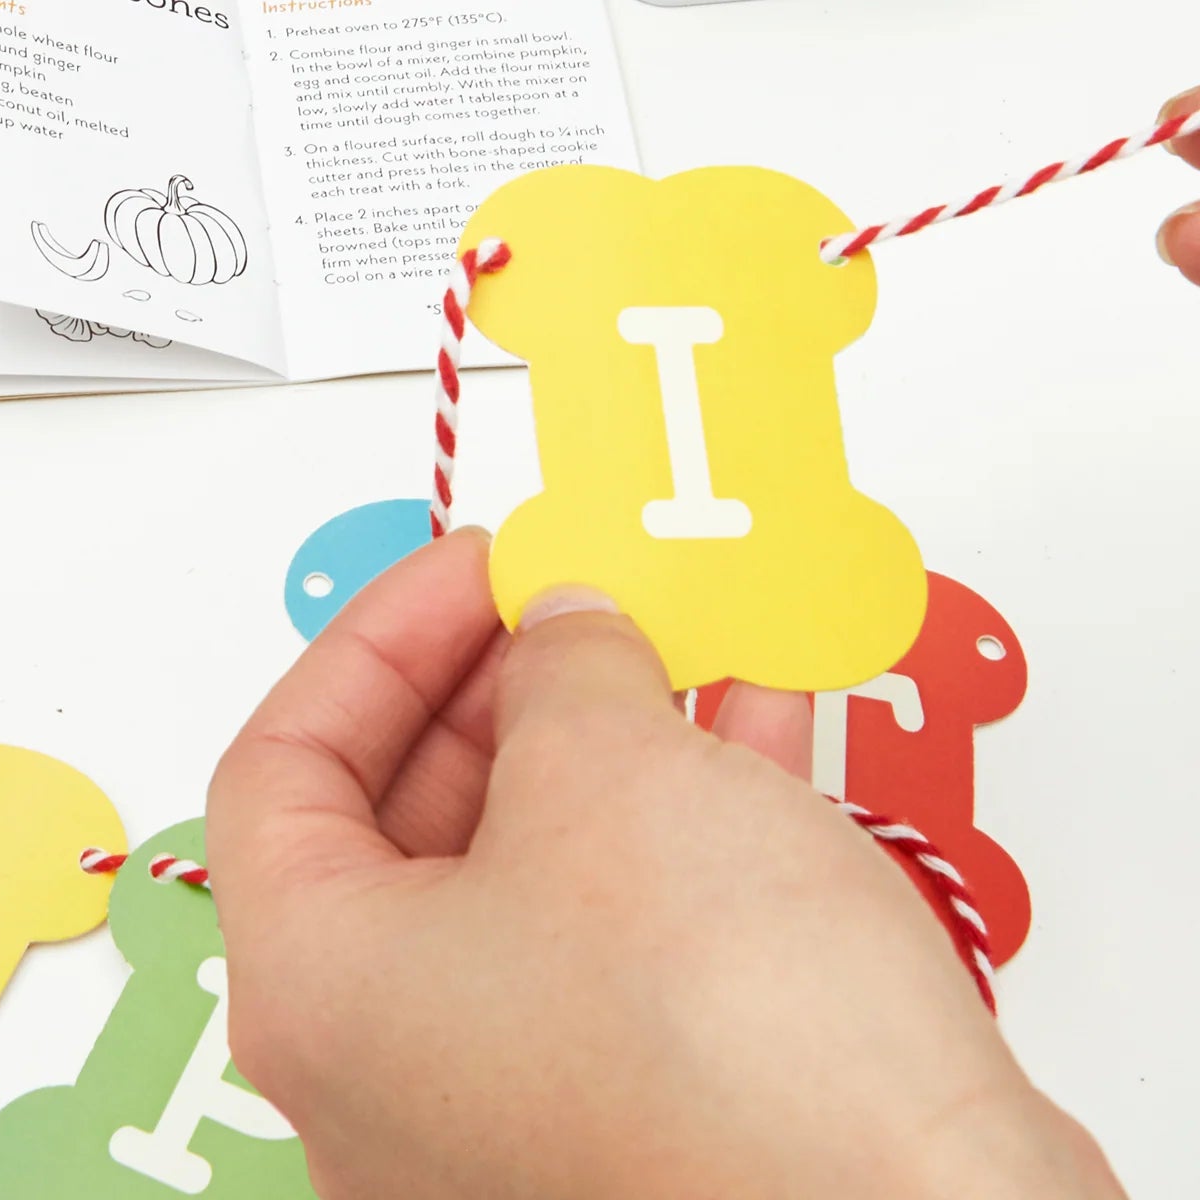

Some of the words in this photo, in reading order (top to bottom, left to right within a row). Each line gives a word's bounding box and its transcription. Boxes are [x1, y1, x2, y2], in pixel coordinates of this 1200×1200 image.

[285, 26, 340, 38] Preheat
[344, 24, 379, 32] oven
[383, 22, 398, 30] to
[32, 34, 79, 54] wheat
[84, 44, 118, 64] flour
[289, 48, 355, 60] Combine
[359, 44, 392, 54] flour
[396, 40, 423, 52] and
[427, 40, 472, 52] ginger
[493, 33, 528, 46] small
[32, 52, 81, 72] ginger
[291, 64, 305, 74] In
[309, 62, 333, 72] the
[336, 58, 373, 71] bowl
[376, 56, 390, 68] of
[407, 56, 450, 65] mixer,
[454, 50, 516, 62] combine
[520, 44, 587, 60] pumpkin,
[293, 79, 320, 90] egg
[324, 74, 350, 86] and
[354, 72, 410, 84] coconut
[440, 65, 470, 77] Add
[474, 64, 497, 75] the
[500, 62, 532, 73] flour
[537, 60, 590, 70] mixture
[19, 81, 74, 107] beaten
[296, 90, 322, 102] and
[327, 89, 352, 100] mix
[356, 85, 389, 98] until
[457, 78, 494, 89] With
[497, 77, 520, 88] the
[525, 76, 564, 86] mixer
[568, 75, 587, 83] on
[297, 106, 328, 116] low,
[332, 101, 378, 114] slowly
[382, 97, 409, 110] add
[413, 97, 454, 107] water
[458, 94, 464, 104] 1
[468, 91, 550, 104] tablespoon
[554, 90, 567, 99] at
[571, 90, 579, 98] a
[19, 122, 64, 140] water
[46, 110, 70, 126] oil,
[74, 118, 129, 138] melted
[300, 120, 332, 131] time
[337, 115, 369, 128] until
[373, 112, 420, 126] dough
[424, 111, 471, 121] comes
[304, 143, 328, 154] On
[332, 144, 340, 152] a
[344, 136, 397, 151] floured
[402, 134, 457, 147] surface,
[461, 131, 485, 142] roll
[488, 128, 536, 143] dough
[539, 130, 555, 138] to
[575, 124, 605, 136] inch
[382, 151, 409, 163] Cut
[412, 148, 445, 160] with
[448, 142, 546, 158] bone-shaped
[550, 140, 598, 153] cookie
[308, 173, 352, 184] cutter
[356, 167, 384, 180] and
[388, 168, 426, 180] press
[430, 162, 469, 174] holes
[473, 162, 487, 172] in
[490, 160, 514, 171] the
[519, 160, 564, 170] center
[311, 186, 345, 199] each
[349, 184, 384, 196] treat
[388, 179, 421, 192] with
[425, 182, 433, 190] a
[314, 212, 353, 224] Place
[357, 208, 367, 220] 2
[372, 206, 419, 218] inches
[423, 204, 461, 217] apart
[373, 221, 408, 234] Bake
[412, 218, 446, 231] until
[318, 237, 387, 254] browned
[391, 236, 431, 250] (tops
[322, 258, 351, 270] firm
[355, 254, 397, 266] when
[324, 271, 360, 285] Cool
[364, 272, 384, 281] on
[400, 267, 433, 278] wire
[616, 304, 754, 540] I
